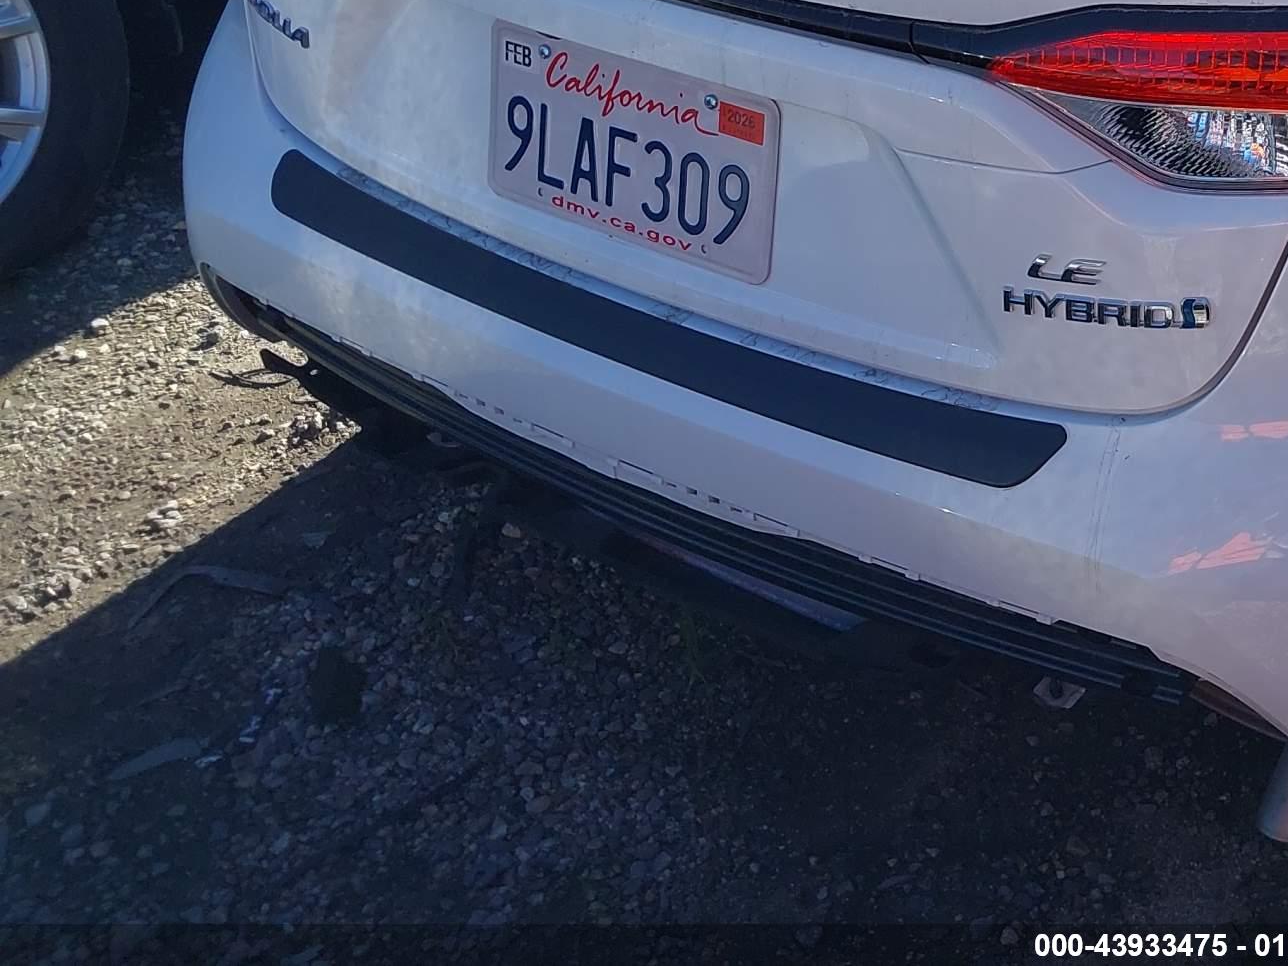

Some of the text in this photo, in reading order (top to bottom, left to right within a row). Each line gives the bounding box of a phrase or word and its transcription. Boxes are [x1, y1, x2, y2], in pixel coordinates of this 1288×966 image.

[504, 40, 533, 68] FEB
[545, 51, 719, 137] California
[504, 94, 751, 245] 9LAF309
[551, 195, 693, 252] dmv.ca.gov
[1027, 253, 1107, 285] LE
[1002, 284, 1176, 330] HYBRID
